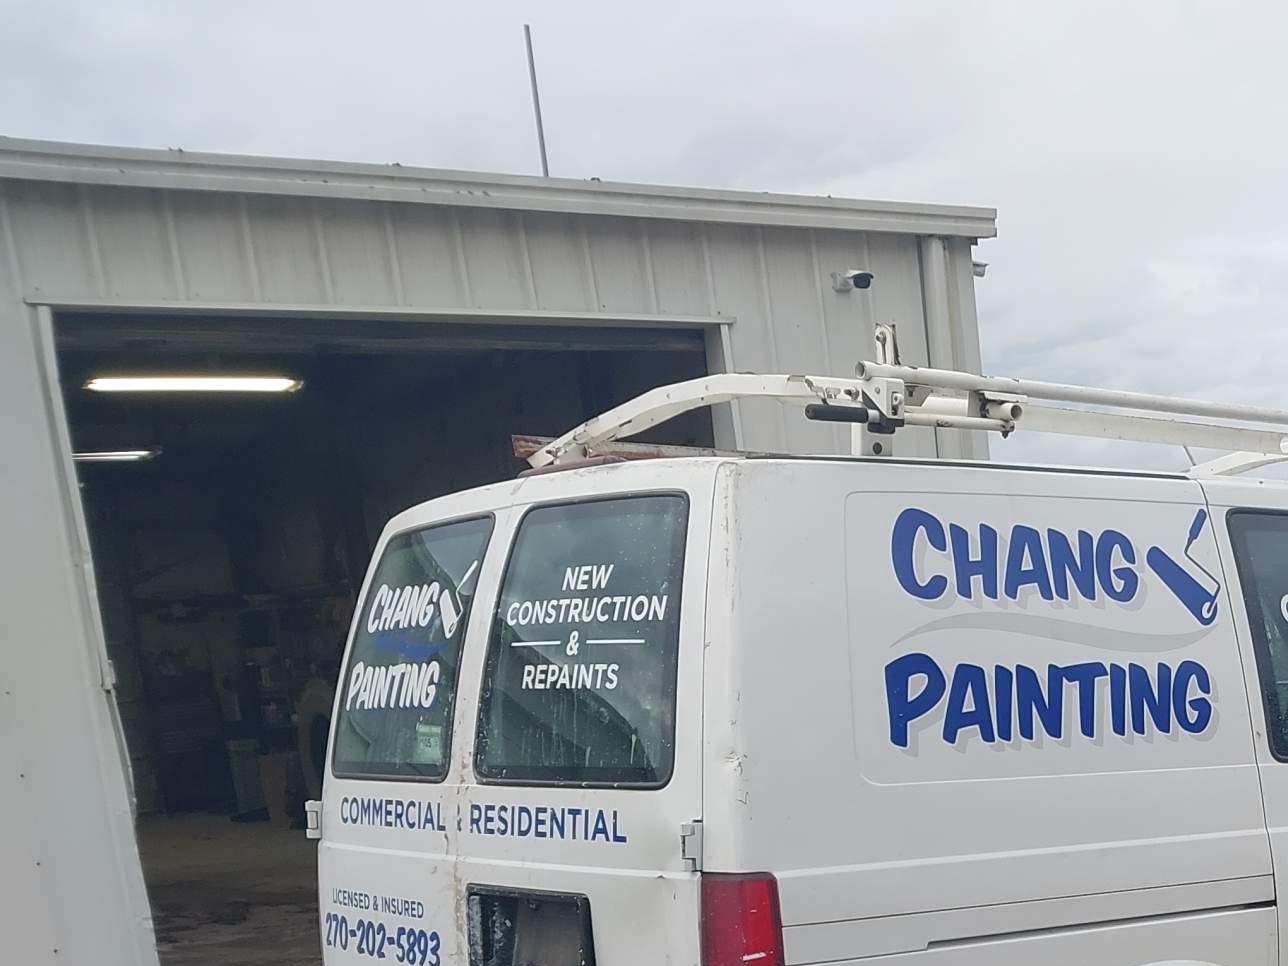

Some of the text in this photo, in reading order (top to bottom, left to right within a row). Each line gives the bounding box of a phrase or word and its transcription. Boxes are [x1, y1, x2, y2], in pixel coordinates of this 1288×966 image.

[891, 507, 1140, 604] CHANG
[561, 564, 613, 592] NEW
[367, 581, 440, 634] CHANG
[507, 595, 667, 626] CONSTRUCTION
[565, 630, 580, 656] &
[346, 660, 440, 711] PAINTING
[521, 663, 619, 690] REPAINTS
[884, 651, 1214, 750] PAINTING
[340, 796, 446, 832] COMMERCIAL
[469, 803, 627, 843] RESIDENTIAL
[332, 887, 424, 919] LICENSED & INSURED
